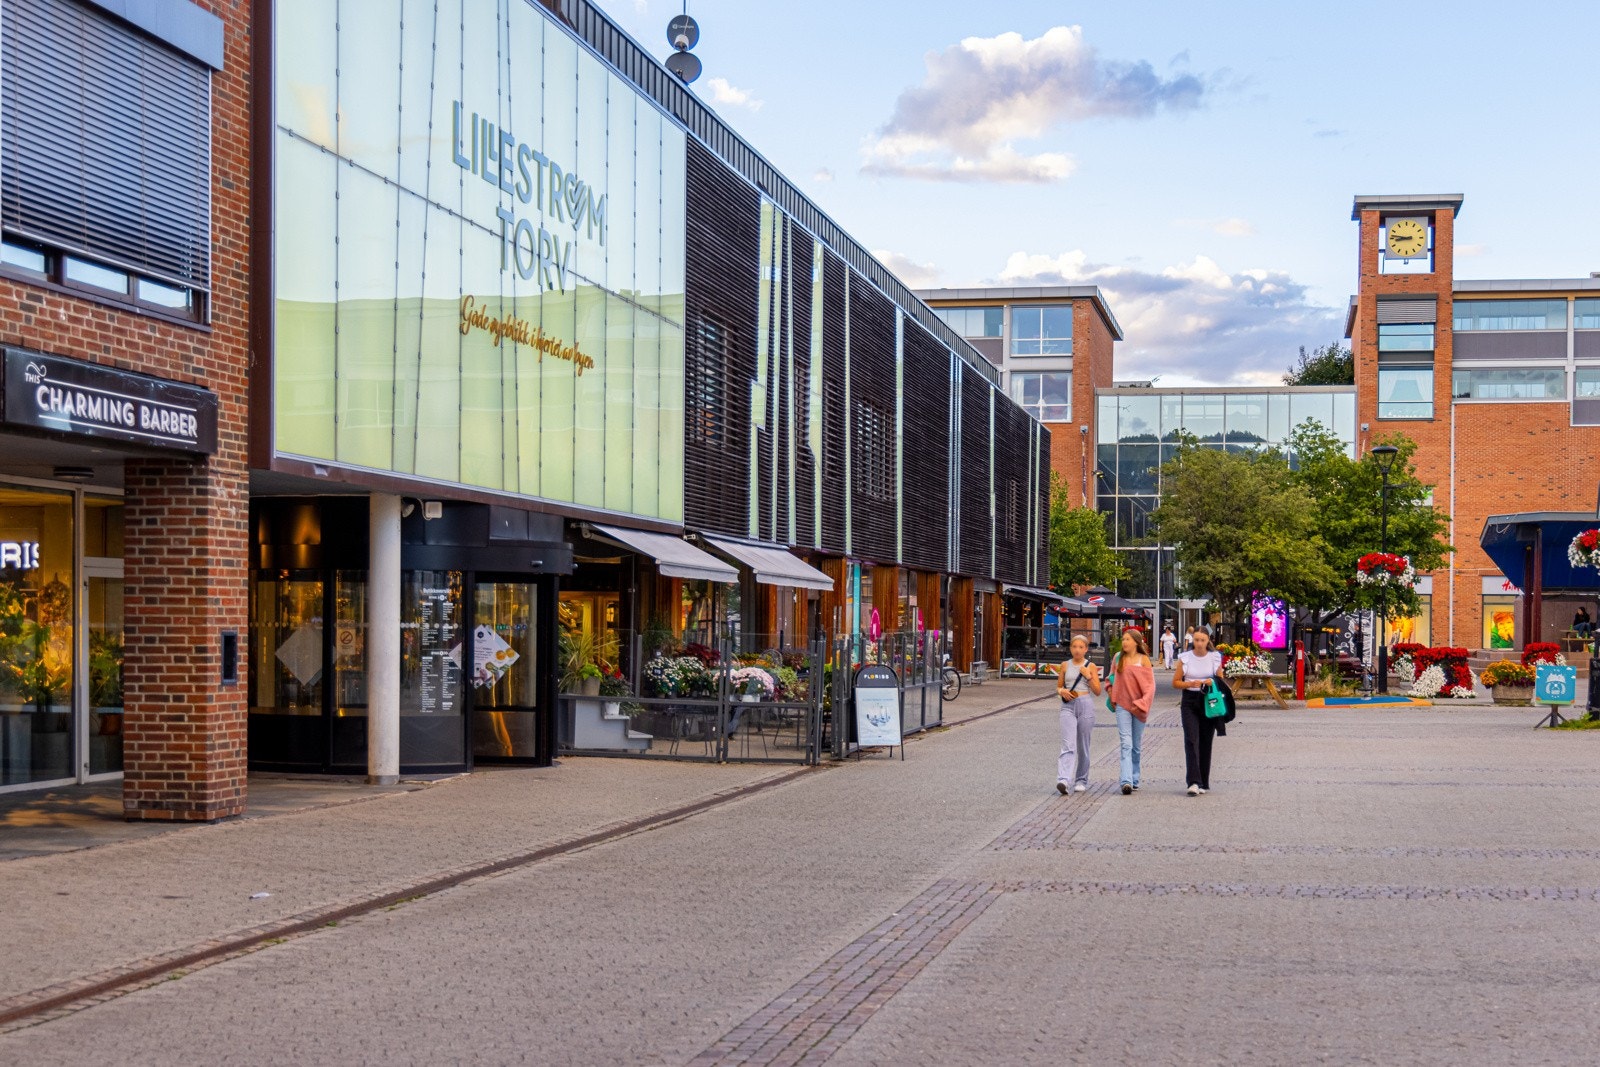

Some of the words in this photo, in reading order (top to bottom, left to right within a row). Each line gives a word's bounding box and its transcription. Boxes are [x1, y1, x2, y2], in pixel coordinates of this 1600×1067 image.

[453, 100, 605, 246] LILLESTRØM
[496, 206, 571, 295] TORV
[24, 372, 41, 384] THIS
[36, 385, 135, 427] CHARMING
[140, 405, 198, 438] BARBER
